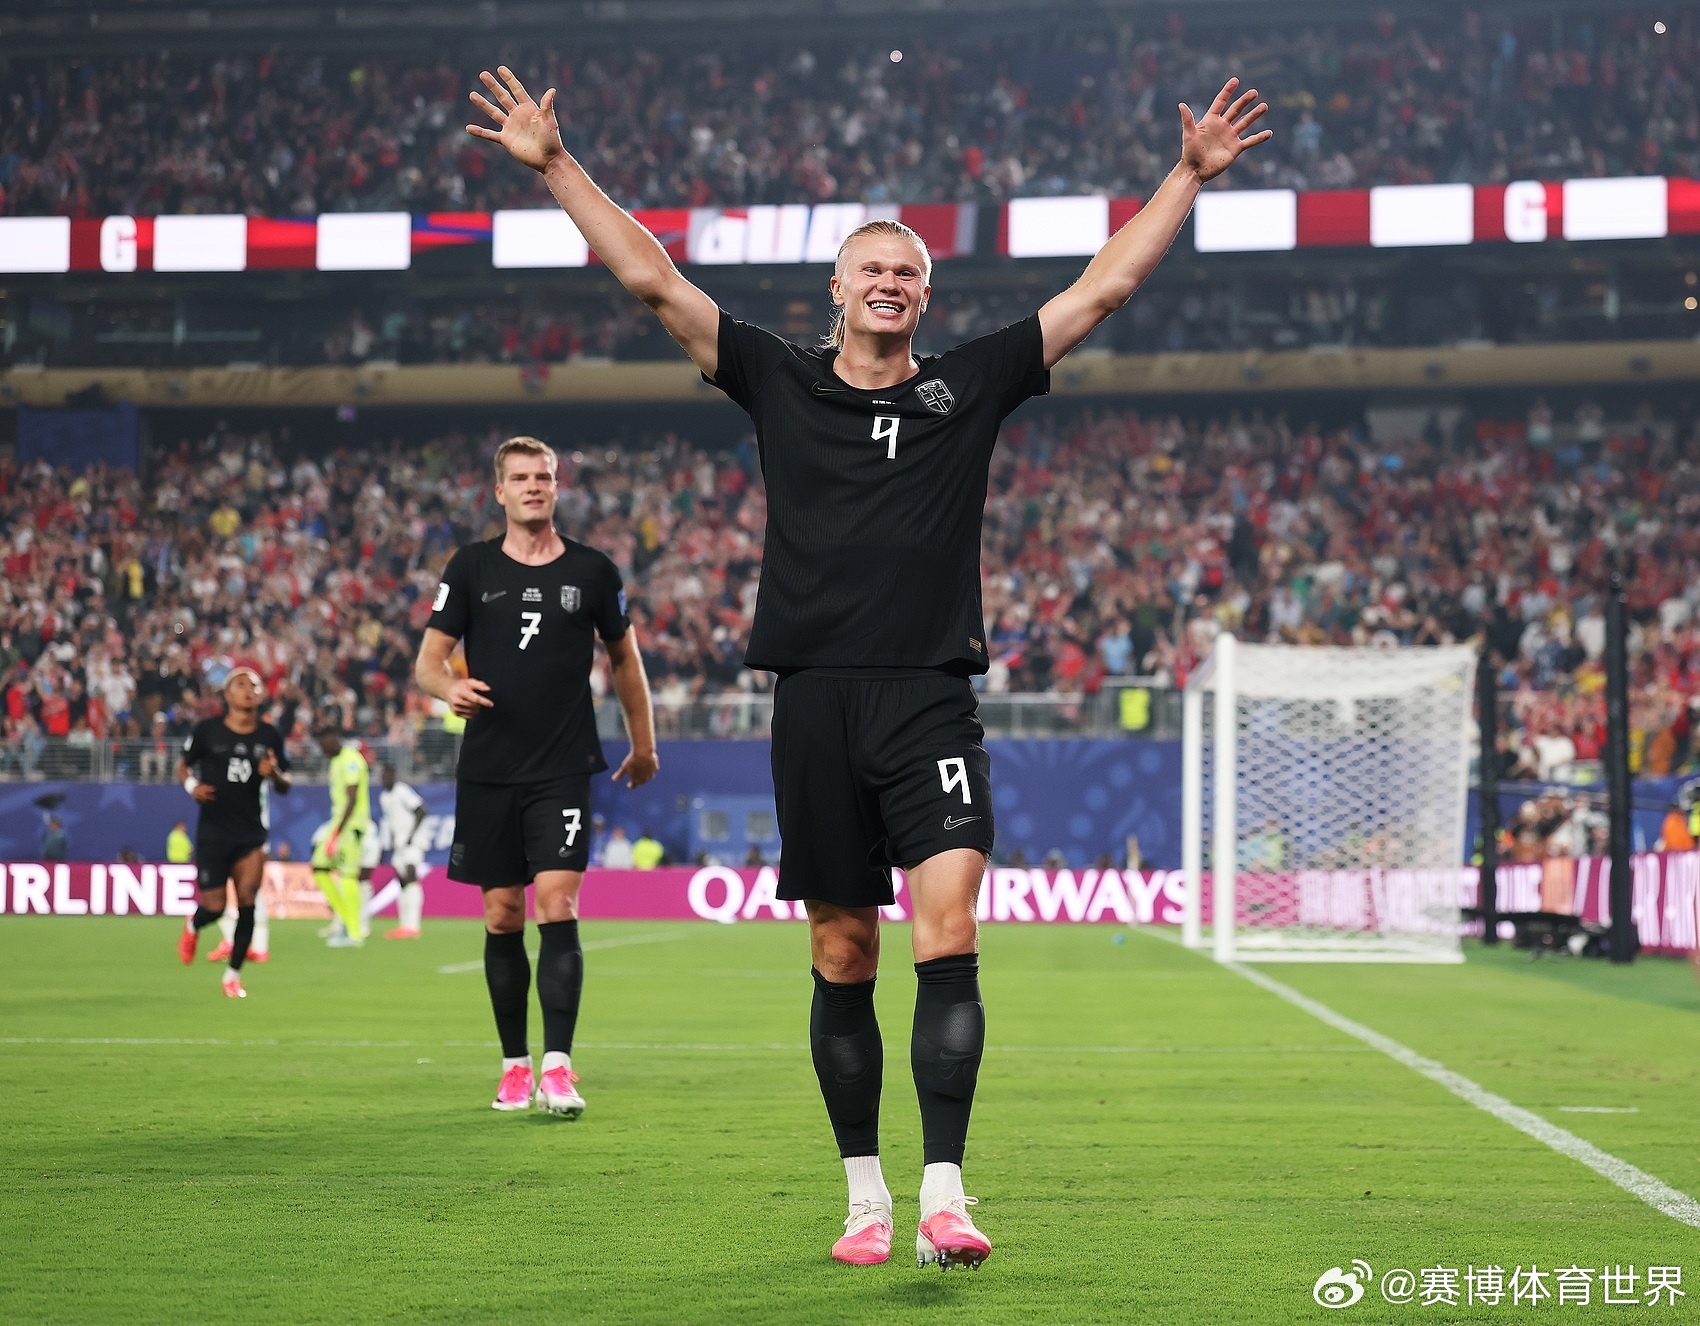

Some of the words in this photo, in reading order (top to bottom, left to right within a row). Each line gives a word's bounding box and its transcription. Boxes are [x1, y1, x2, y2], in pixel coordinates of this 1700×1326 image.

[870, 414, 901, 460] 9
[518, 611, 542, 651] 7
[937, 757, 972, 805] 9
[562, 808, 582, 847] 7
